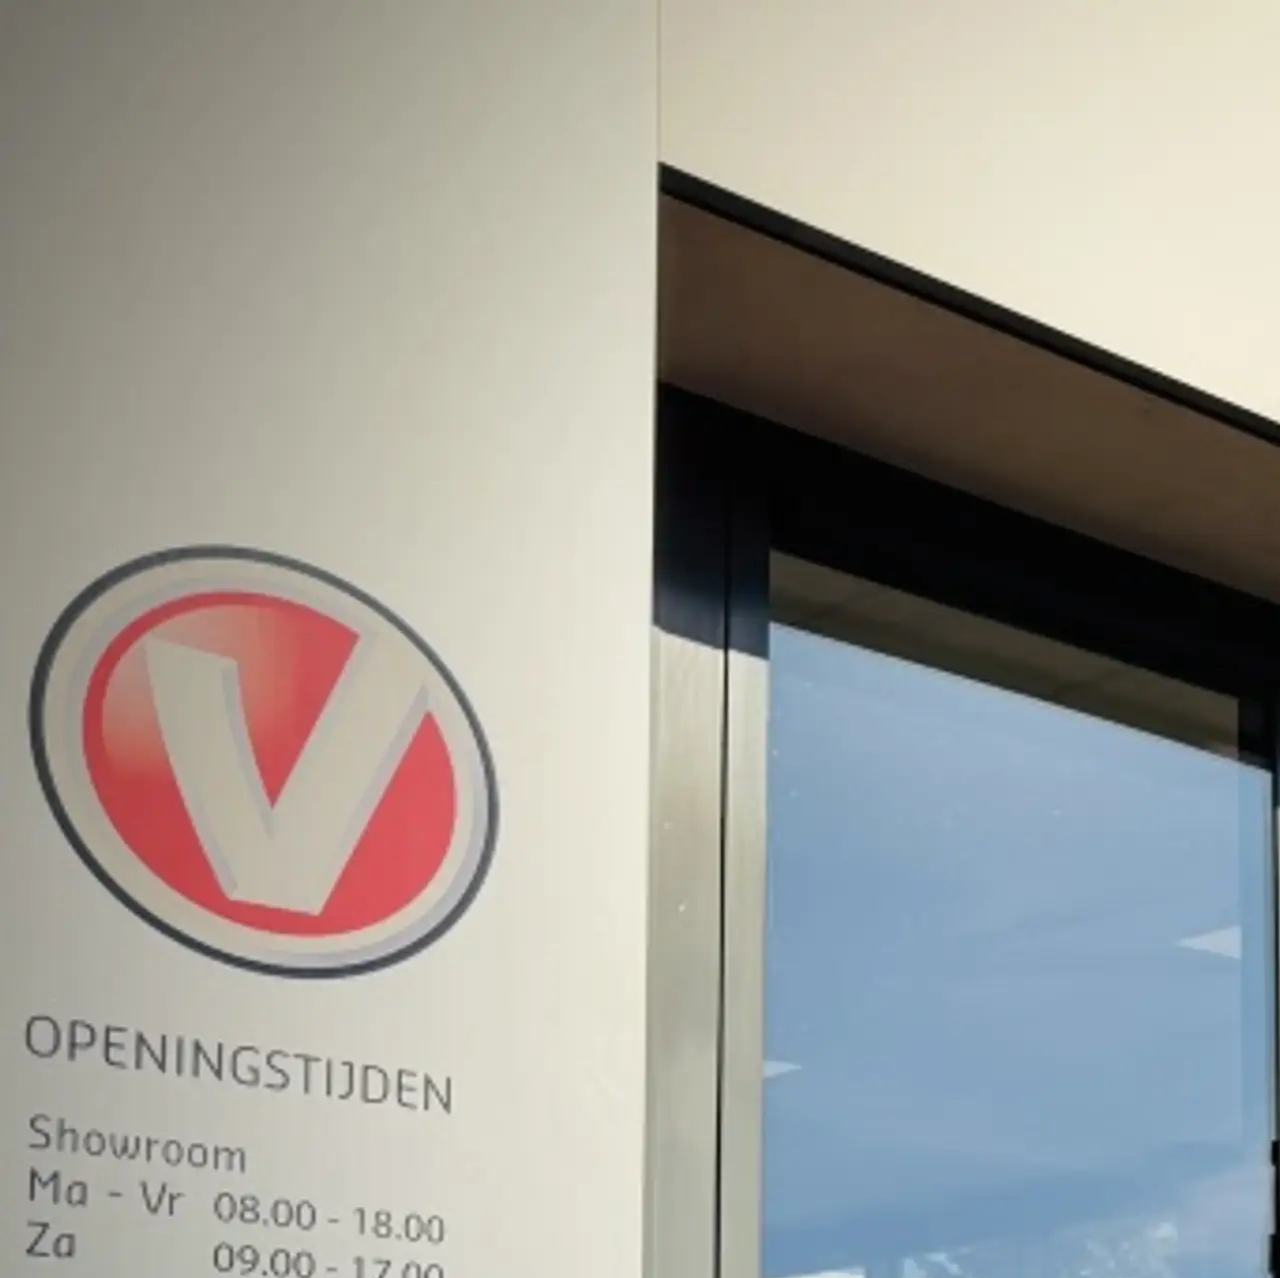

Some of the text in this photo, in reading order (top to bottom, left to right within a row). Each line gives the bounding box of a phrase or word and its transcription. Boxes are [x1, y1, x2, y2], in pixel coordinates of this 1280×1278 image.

[144, 628, 432, 916] V
[24, 1015, 453, 1115] OPENINGSTIJDEN
[28, 1113, 247, 1174] Showroom
[25, 1221, 76, 1259] Za
[28, 1167, 88, 1208] Ma
[139, 1179, 185, 1217] Vr
[213, 1191, 317, 1232] 08.00
[355, 1207, 446, 1245] 18.00
